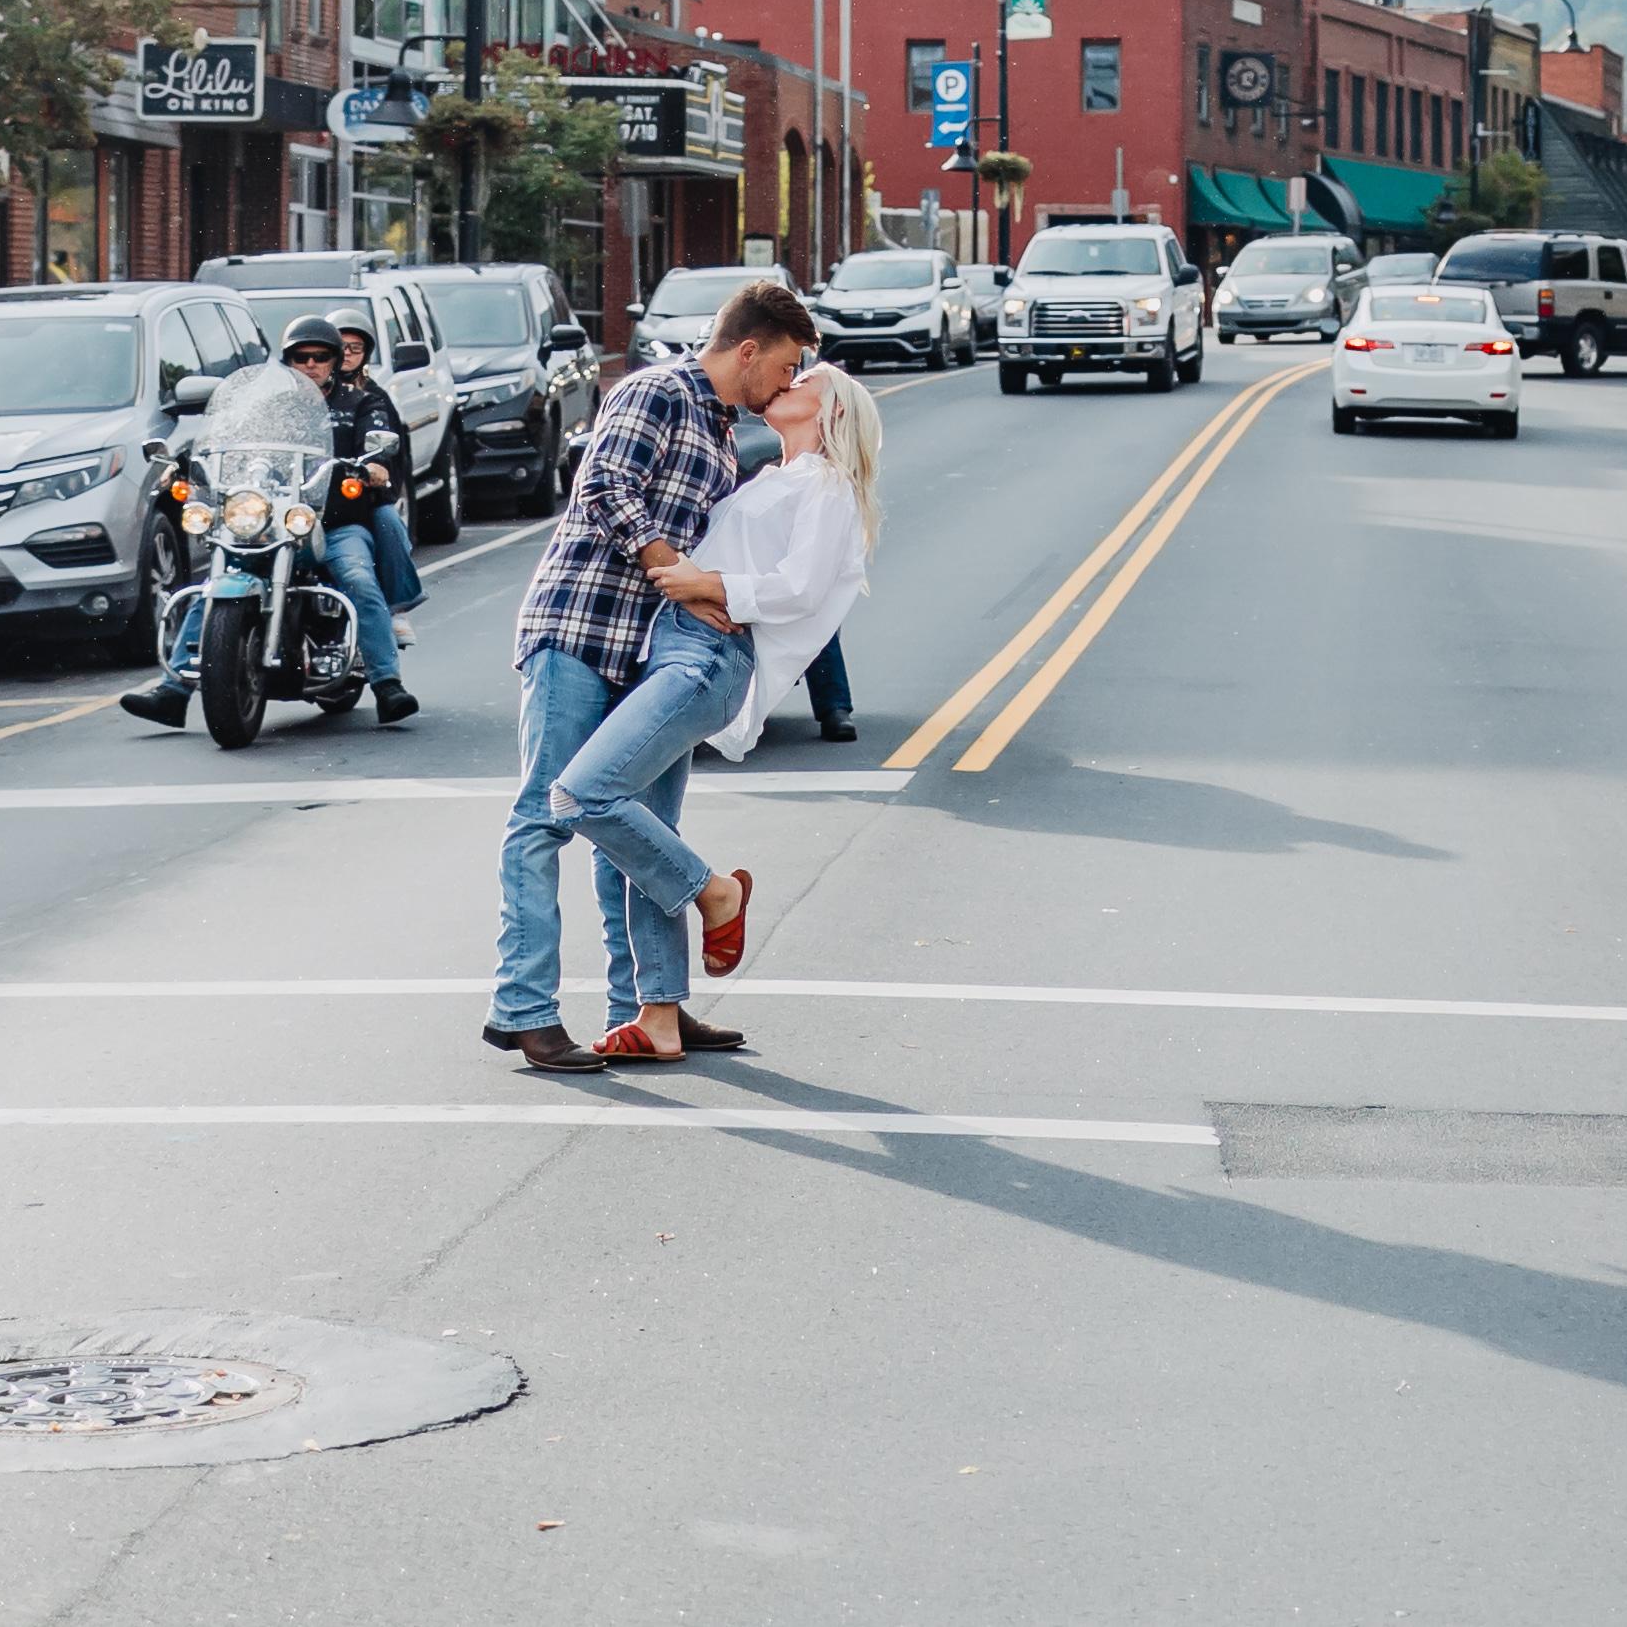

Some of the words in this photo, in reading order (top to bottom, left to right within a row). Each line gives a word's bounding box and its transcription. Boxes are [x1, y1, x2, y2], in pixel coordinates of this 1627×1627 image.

[144, 49, 254, 100] Lililu
[945, 76, 959, 94] P
[166, 98, 194, 111] ON
[200, 98, 249, 112] KING
